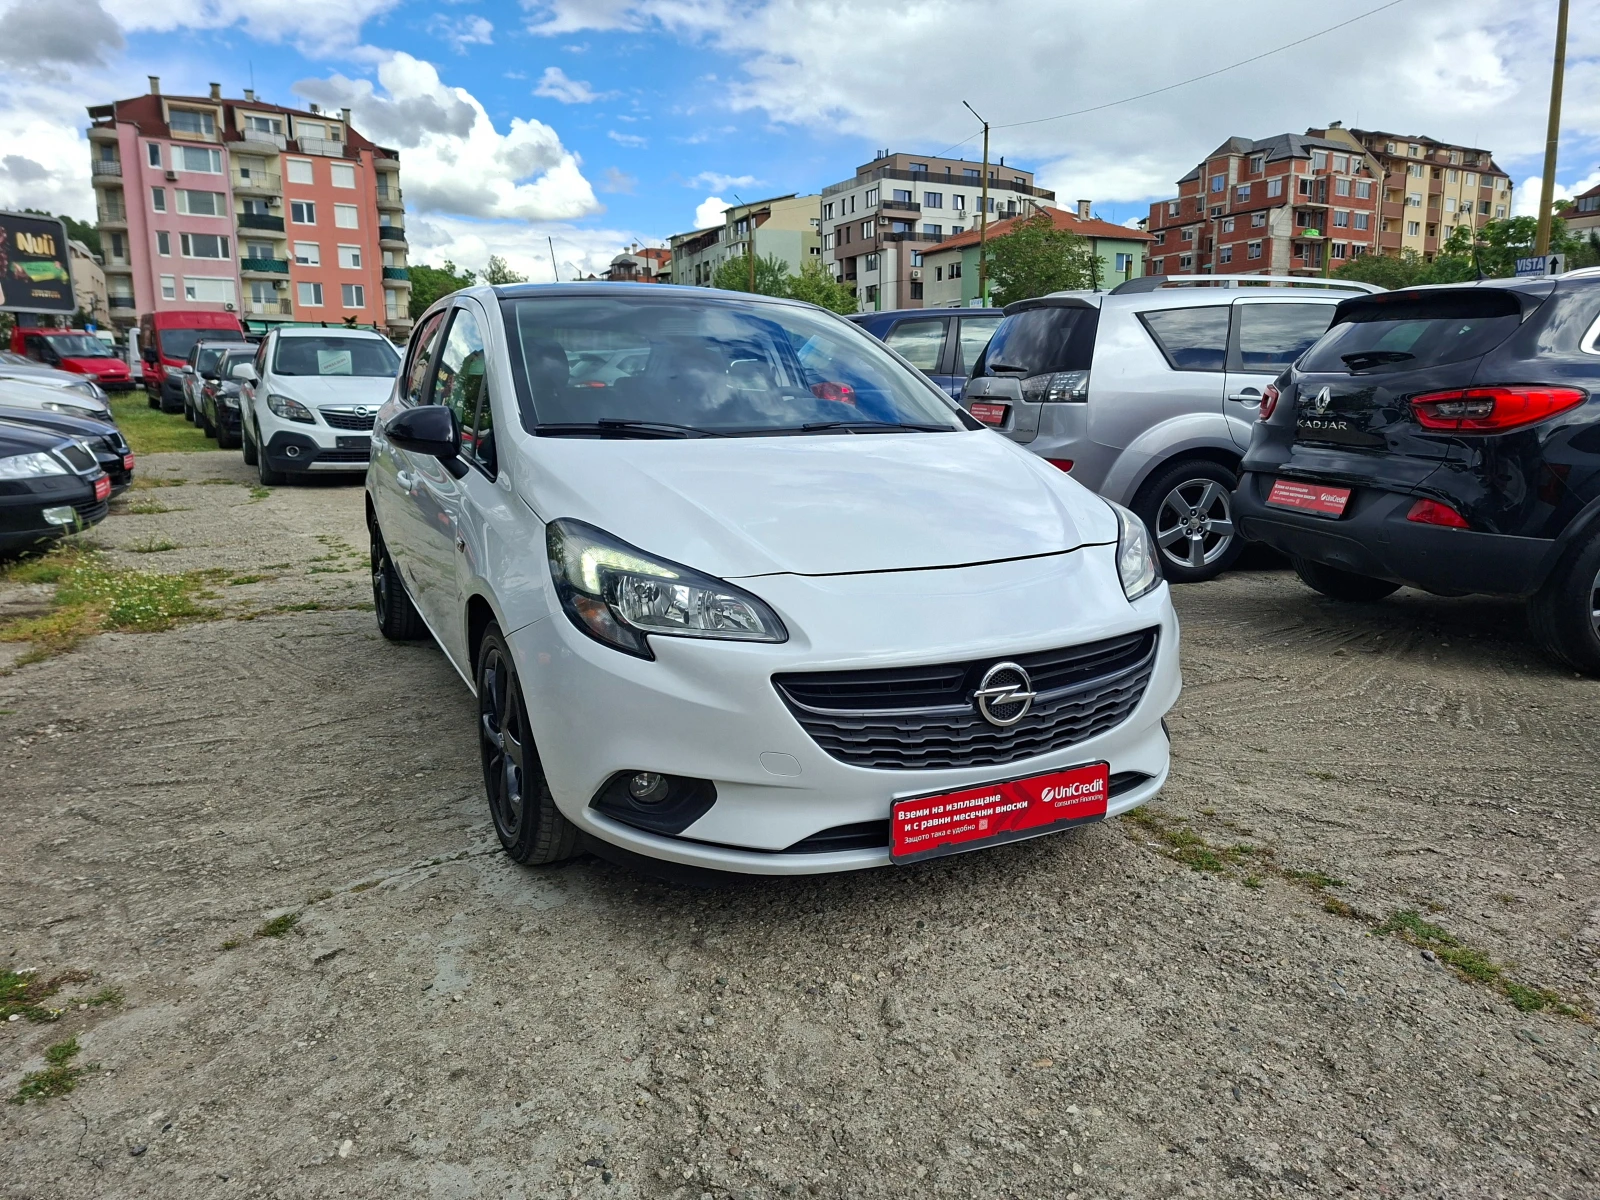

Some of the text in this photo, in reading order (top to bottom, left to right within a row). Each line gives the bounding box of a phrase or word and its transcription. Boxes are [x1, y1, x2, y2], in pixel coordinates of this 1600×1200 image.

[16, 232, 56, 256] Nuii
[1516, 257, 1544, 271] VISTA
[1296, 419, 1347, 430] KADJAR
[1055, 778, 1103, 799] UniCredit
[898, 794, 1001, 820] Вземи на изплащане
[1054, 794, 1103, 808] Consumer Financing
[904, 800, 1028, 832] и с равни месечни вноски
[904, 833, 930, 844] Защото
[931, 831, 946, 839] така
[952, 823, 976, 835] удобно
